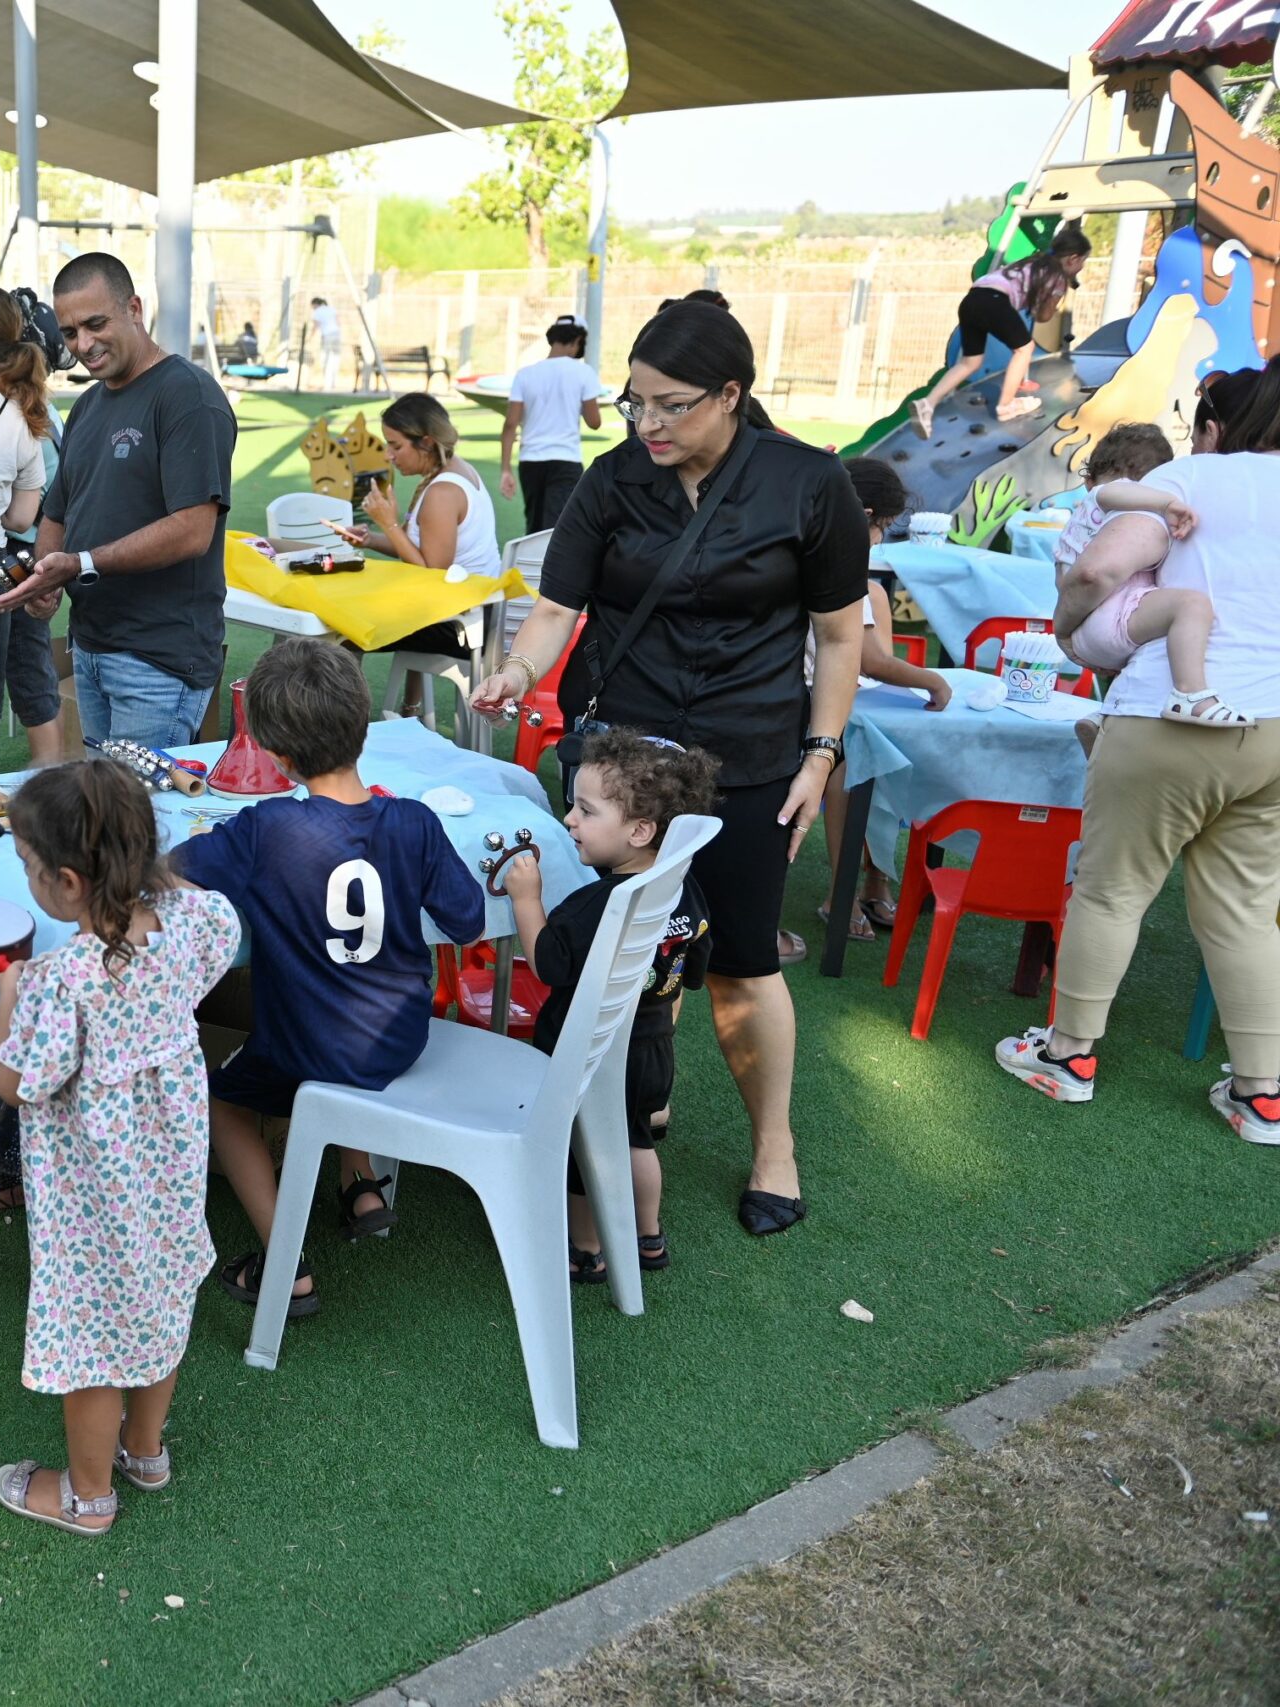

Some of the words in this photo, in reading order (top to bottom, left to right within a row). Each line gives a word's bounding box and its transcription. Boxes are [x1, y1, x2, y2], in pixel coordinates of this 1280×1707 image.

[325, 858, 385, 964] 9
[667, 915, 691, 927] AGO
[665, 924, 689, 936] ULLS
